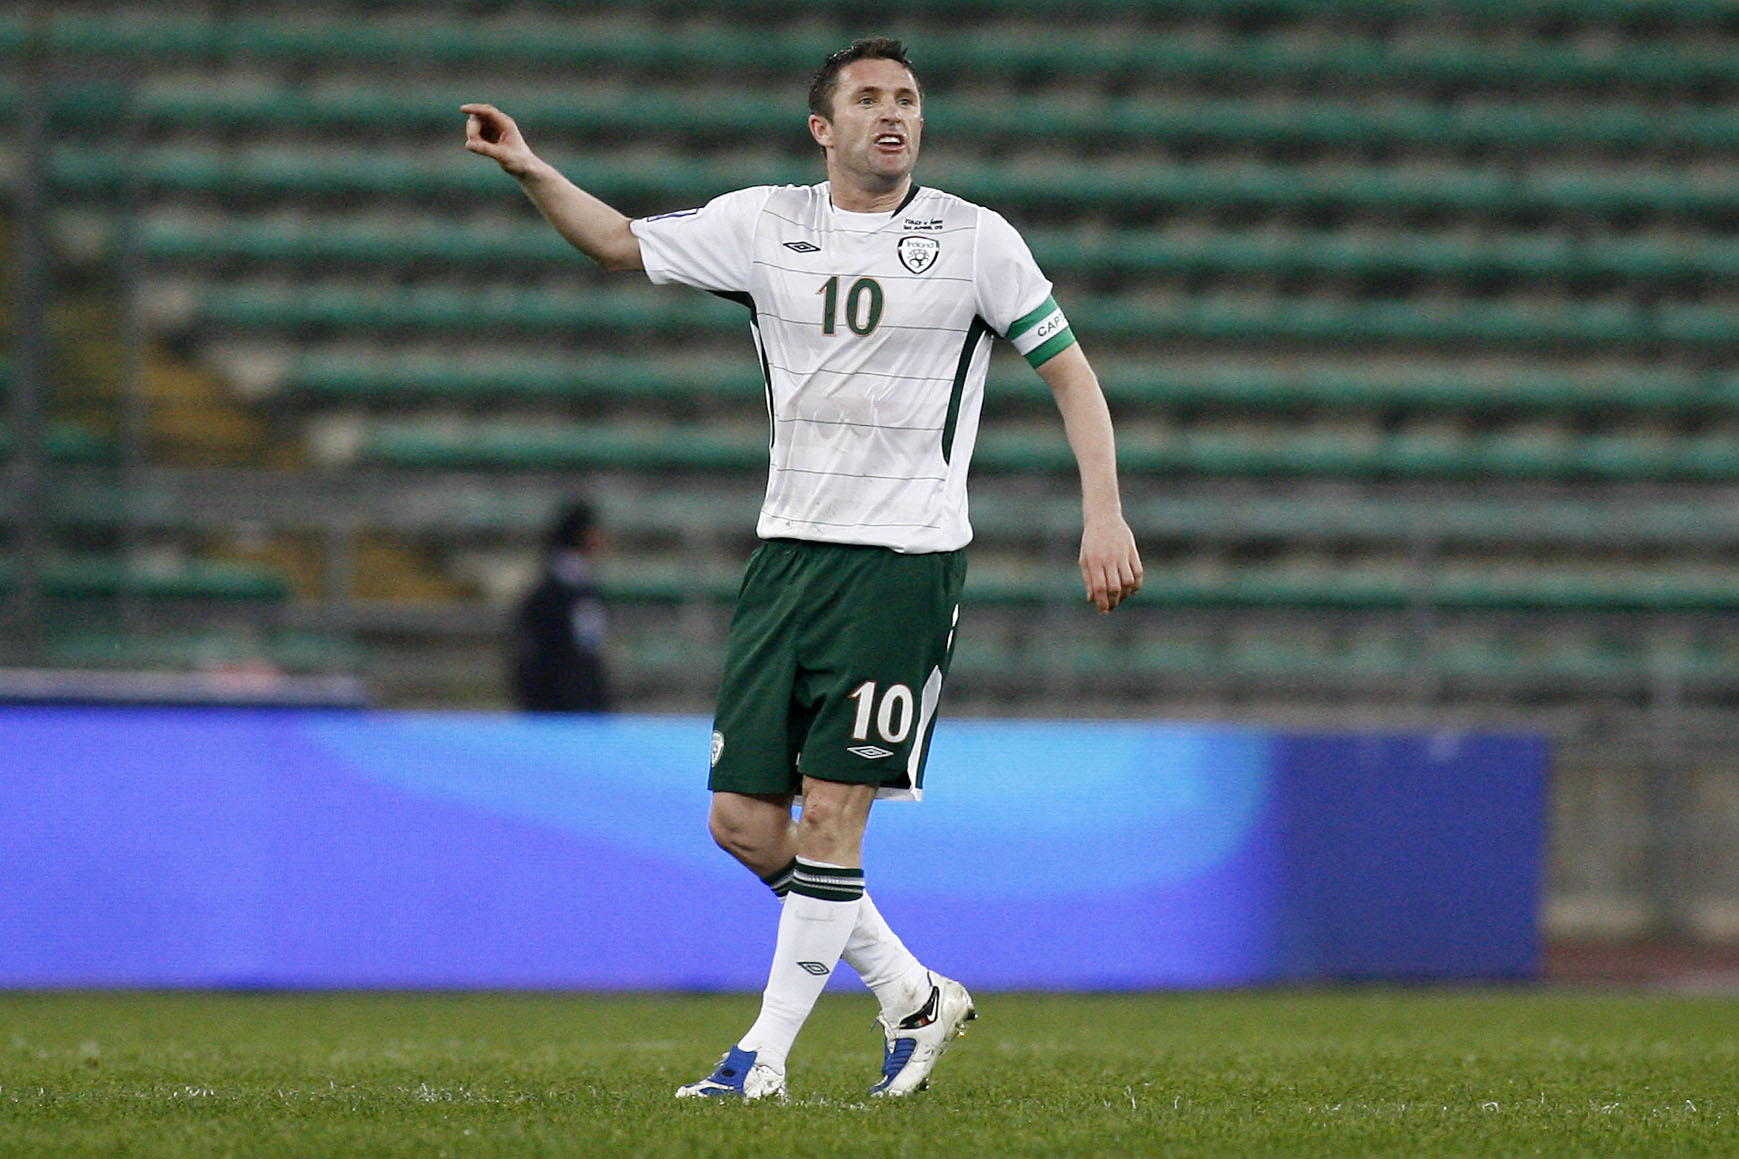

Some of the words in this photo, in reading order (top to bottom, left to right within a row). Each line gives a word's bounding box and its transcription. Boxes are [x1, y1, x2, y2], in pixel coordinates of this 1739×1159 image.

[907, 240, 934, 248] Ireland
[815, 275, 886, 337] 10
[848, 680, 914, 743] 10
